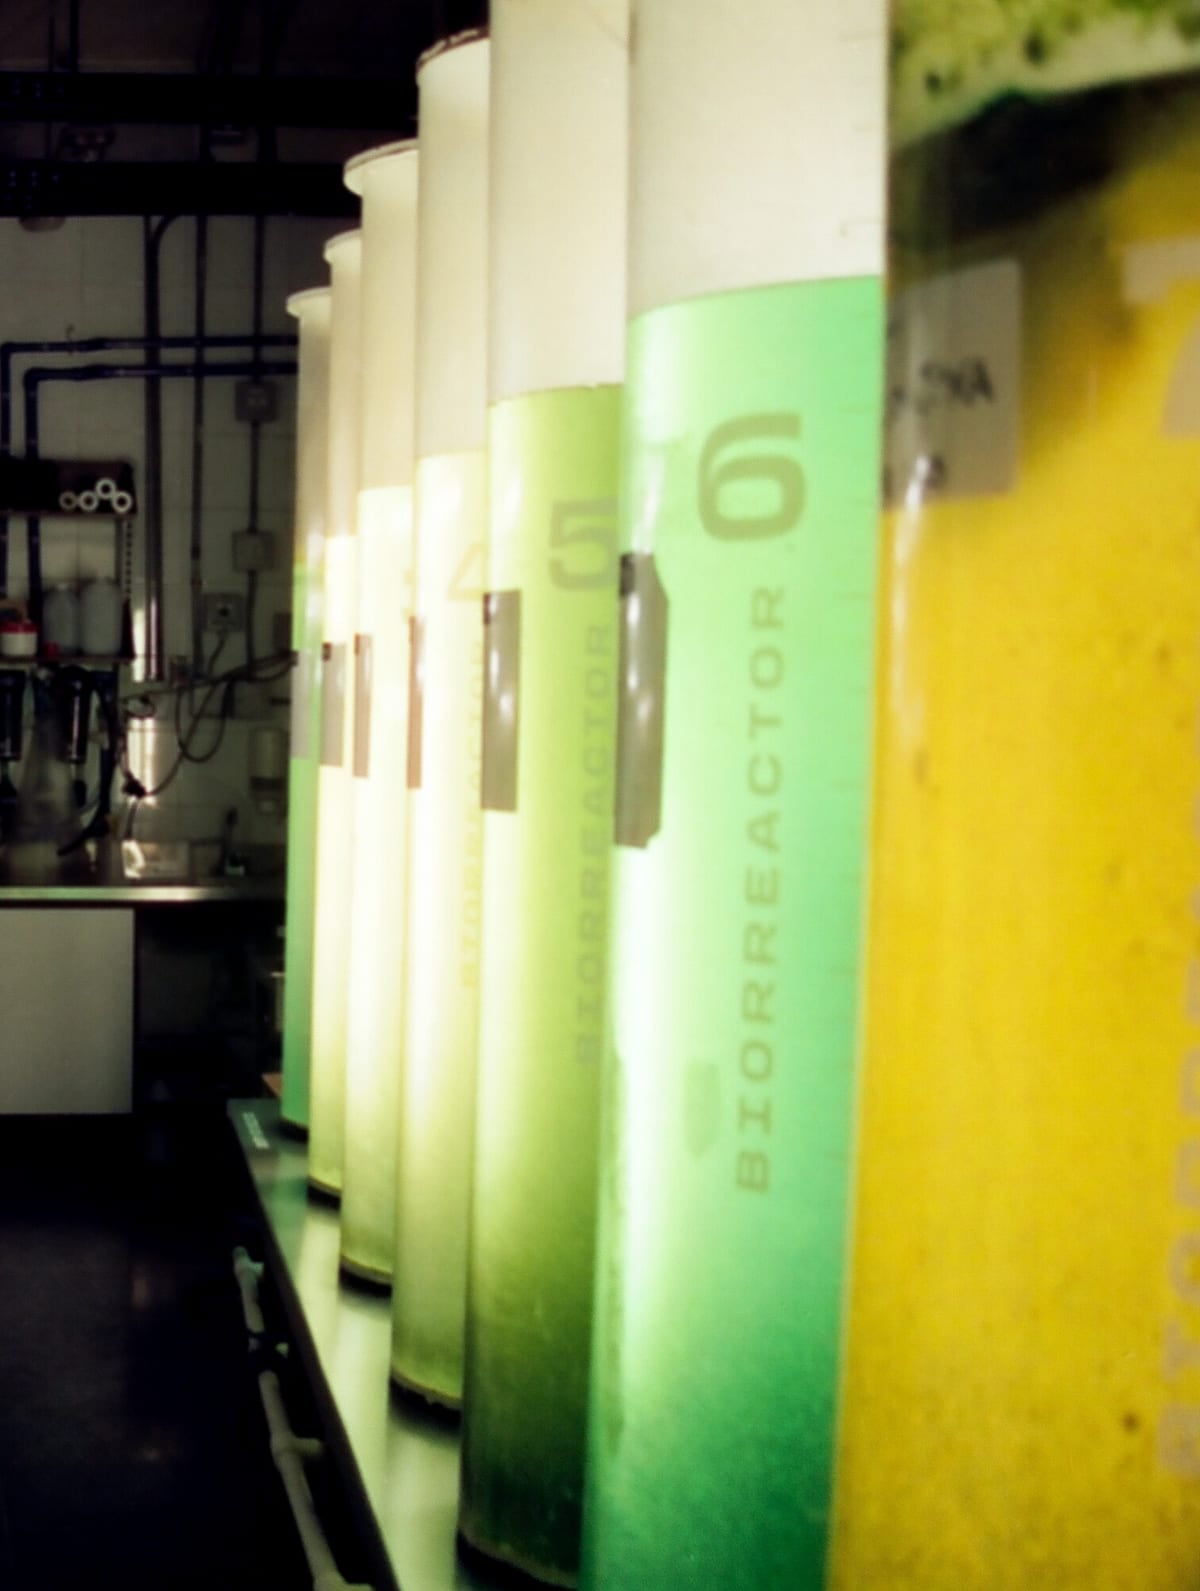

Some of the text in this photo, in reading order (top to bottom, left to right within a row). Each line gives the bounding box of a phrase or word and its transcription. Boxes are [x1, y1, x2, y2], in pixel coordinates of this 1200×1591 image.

[548, 497, 618, 591] 5
[697, 411, 807, 543] 6
[574, 623, 611, 1065] BIORREACTOR
[736, 586, 786, 1193] BIORREACTOR
